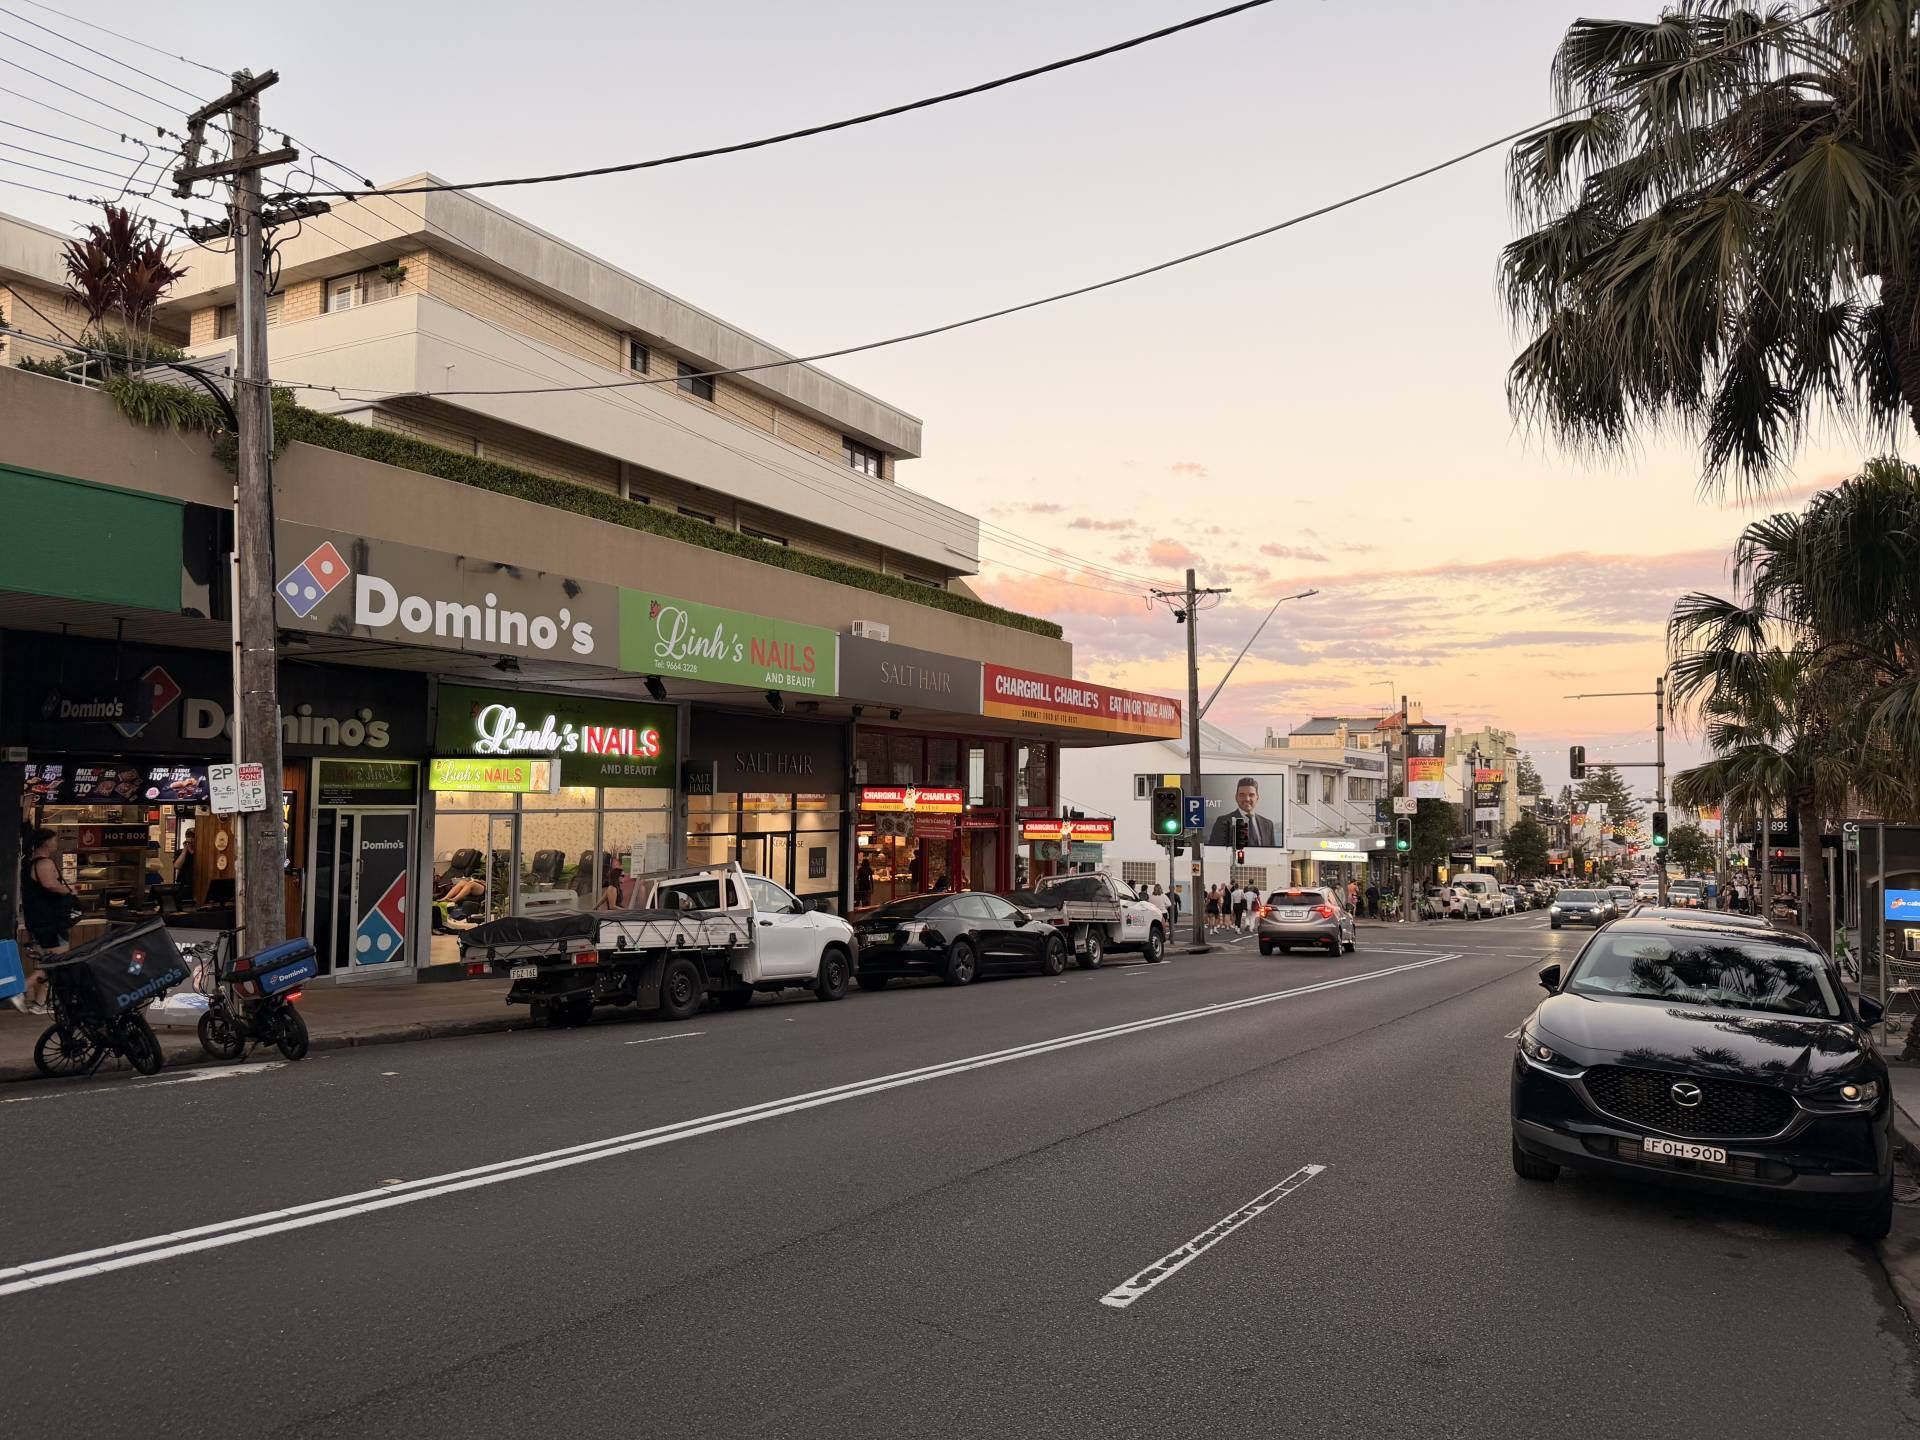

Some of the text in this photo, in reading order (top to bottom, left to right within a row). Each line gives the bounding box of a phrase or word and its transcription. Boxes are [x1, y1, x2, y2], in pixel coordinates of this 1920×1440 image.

[355, 574, 595, 655] Domino's
[654, 606, 816, 673] Linh's NAILS
[654, 659, 698, 674] Tel: 9664 3228
[765, 672, 816, 688] AND BEAUTY
[880, 660, 951, 694] SALT HAIR
[995, 675, 1176, 720] CHARGRILL CHARLIE'S EAT IN OR TAKE AWAY
[60, 699, 123, 718] Domino's
[474, 704, 660, 758] Linh's NAILS
[600, 764, 658, 776] AND BEAUTY
[736, 752, 817, 776] SALT HAIR
[211, 768, 232, 780] 2P
[440, 761, 522, 784] Linh's NAILS
[689, 773, 712, 782] SALT
[689, 784, 712, 793] HAIR
[864, 791, 960, 801] CHARGRILL CHARLIE'S
[1189, 800, 1200, 812] P
[104, 832, 146, 840] HOT BOX
[362, 840, 404, 850] Domino's
[278, 966, 308, 982] Domino's
[117, 968, 182, 1008] Domino's
